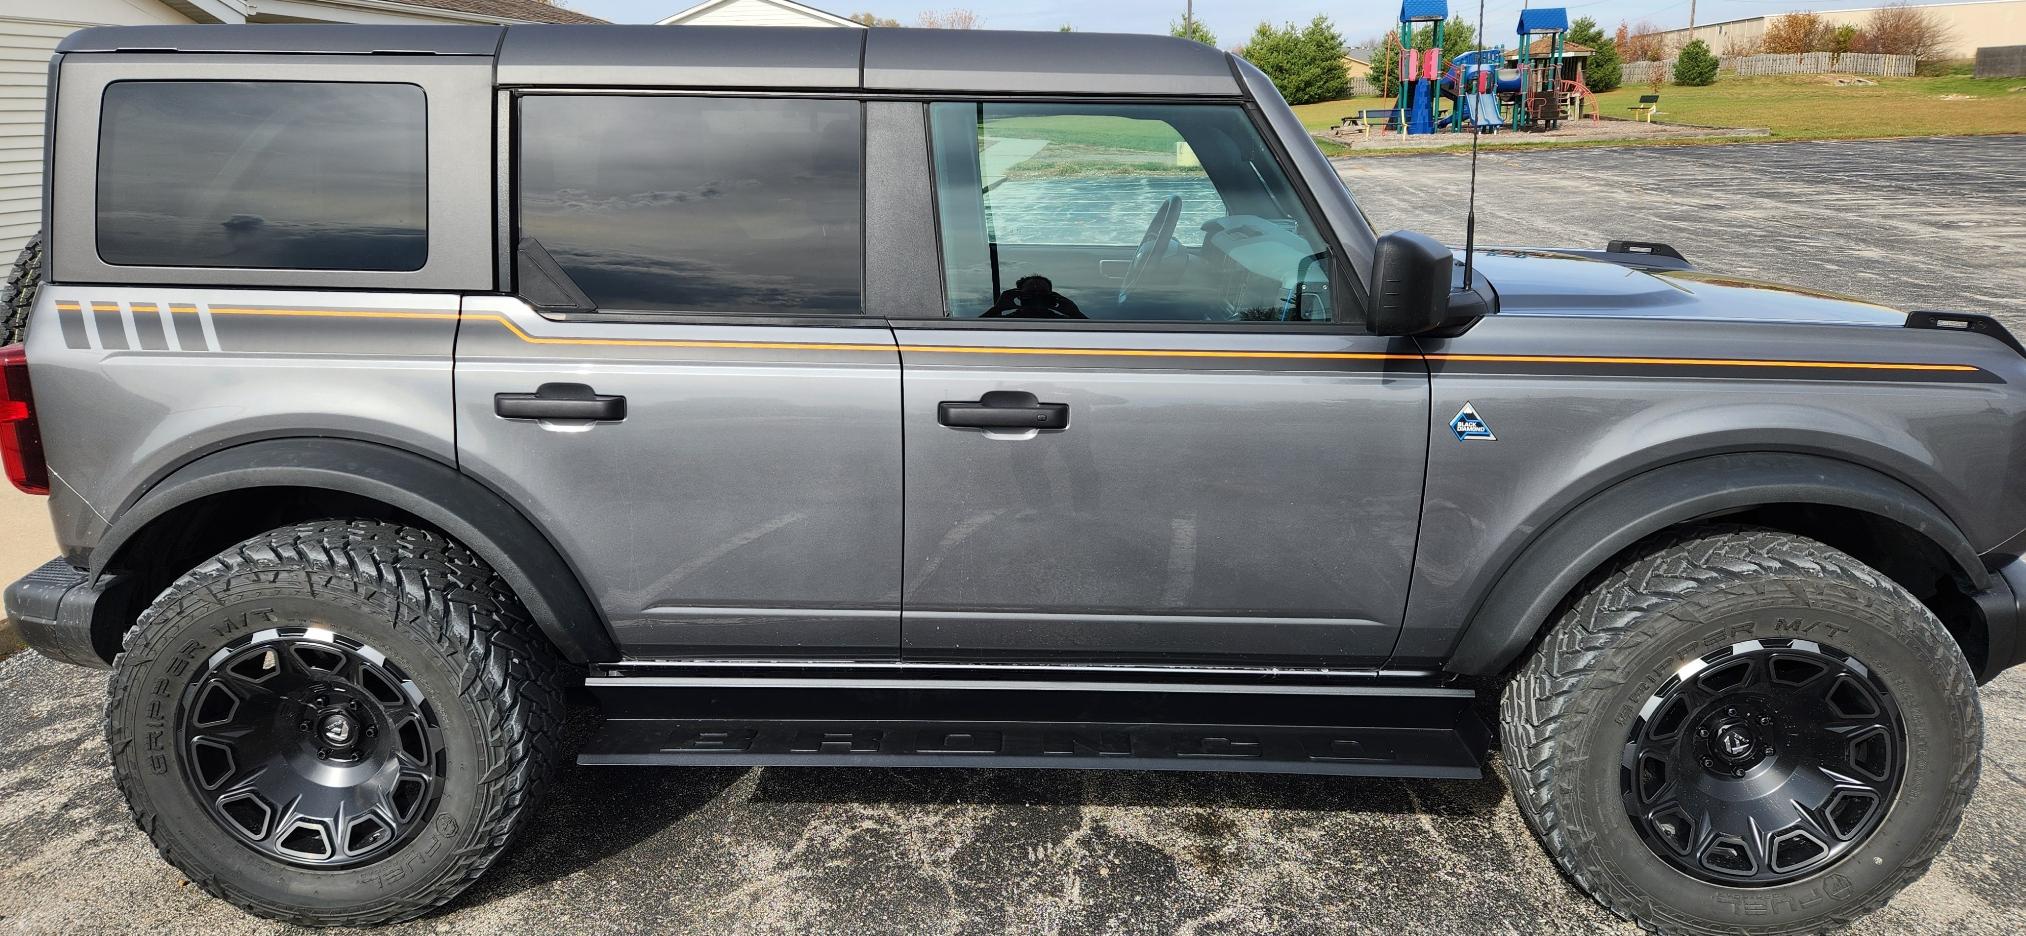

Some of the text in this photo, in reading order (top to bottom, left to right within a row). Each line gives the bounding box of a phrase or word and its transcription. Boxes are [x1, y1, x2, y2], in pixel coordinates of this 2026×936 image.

[146, 607, 278, 776] GRIPPER M/T
[1614, 616, 1851, 729] GRIPPER M/T
[659, 728, 1397, 760] BRONCO
[1716, 889, 1823, 916] FUEL
